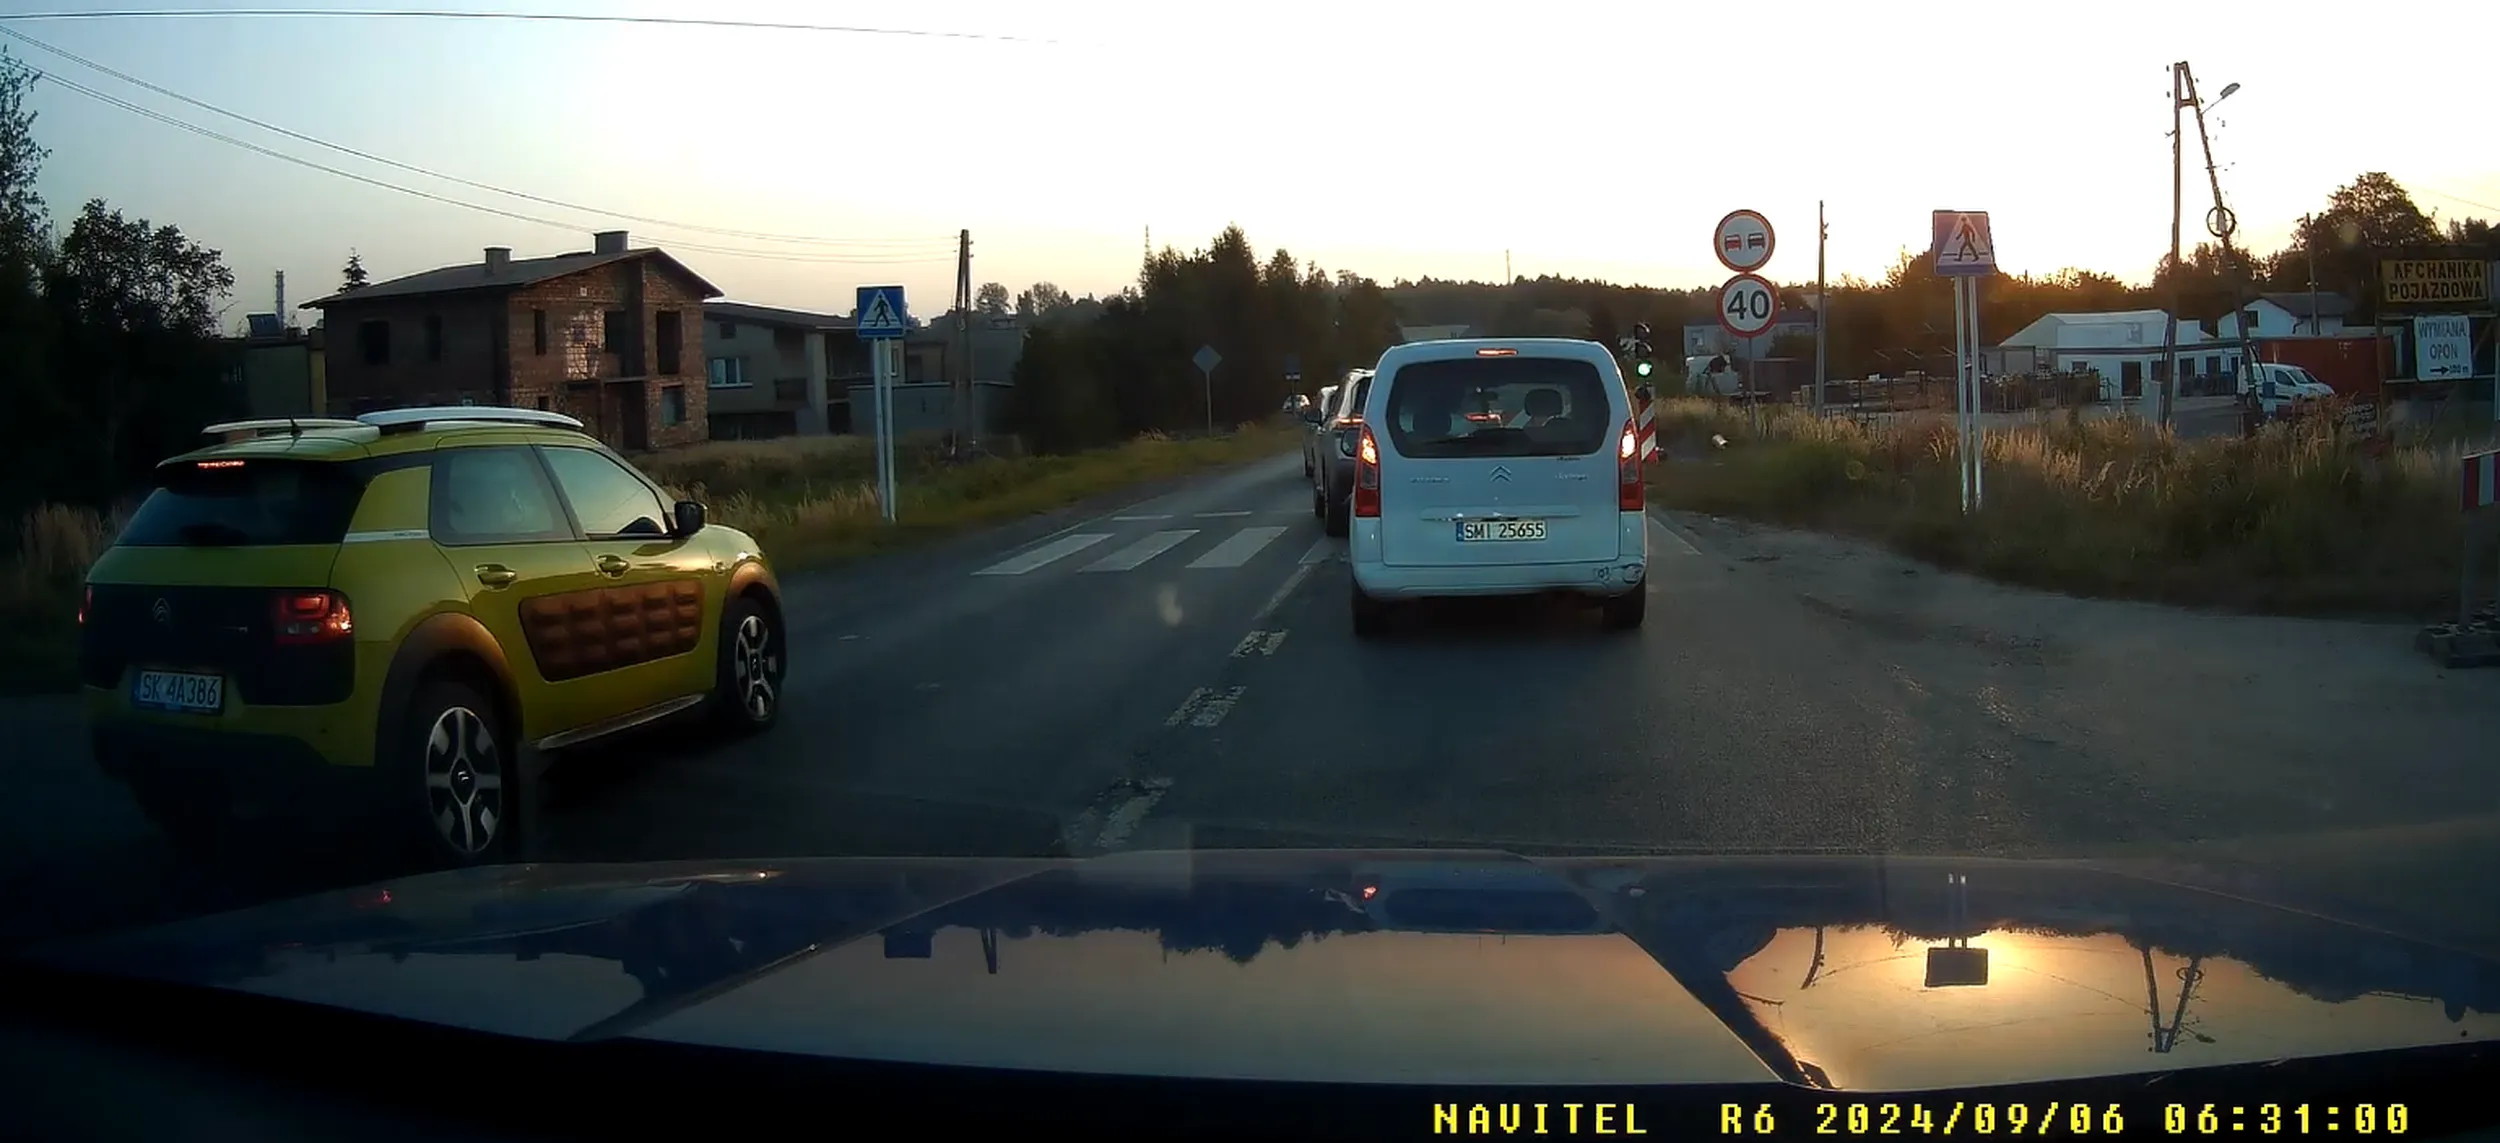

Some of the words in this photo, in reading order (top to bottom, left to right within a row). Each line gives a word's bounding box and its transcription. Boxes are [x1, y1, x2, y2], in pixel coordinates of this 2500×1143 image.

[2389, 281, 2484, 300] POJAZDOWA
[1727, 290, 1770, 320] 40
[2429, 343, 2459, 360] OPON
[1464, 523, 1491, 539] SMI
[1498, 522, 1545, 538] 25655
[143, 674, 161, 701] SK
[165, 675, 219, 706] 4A386
